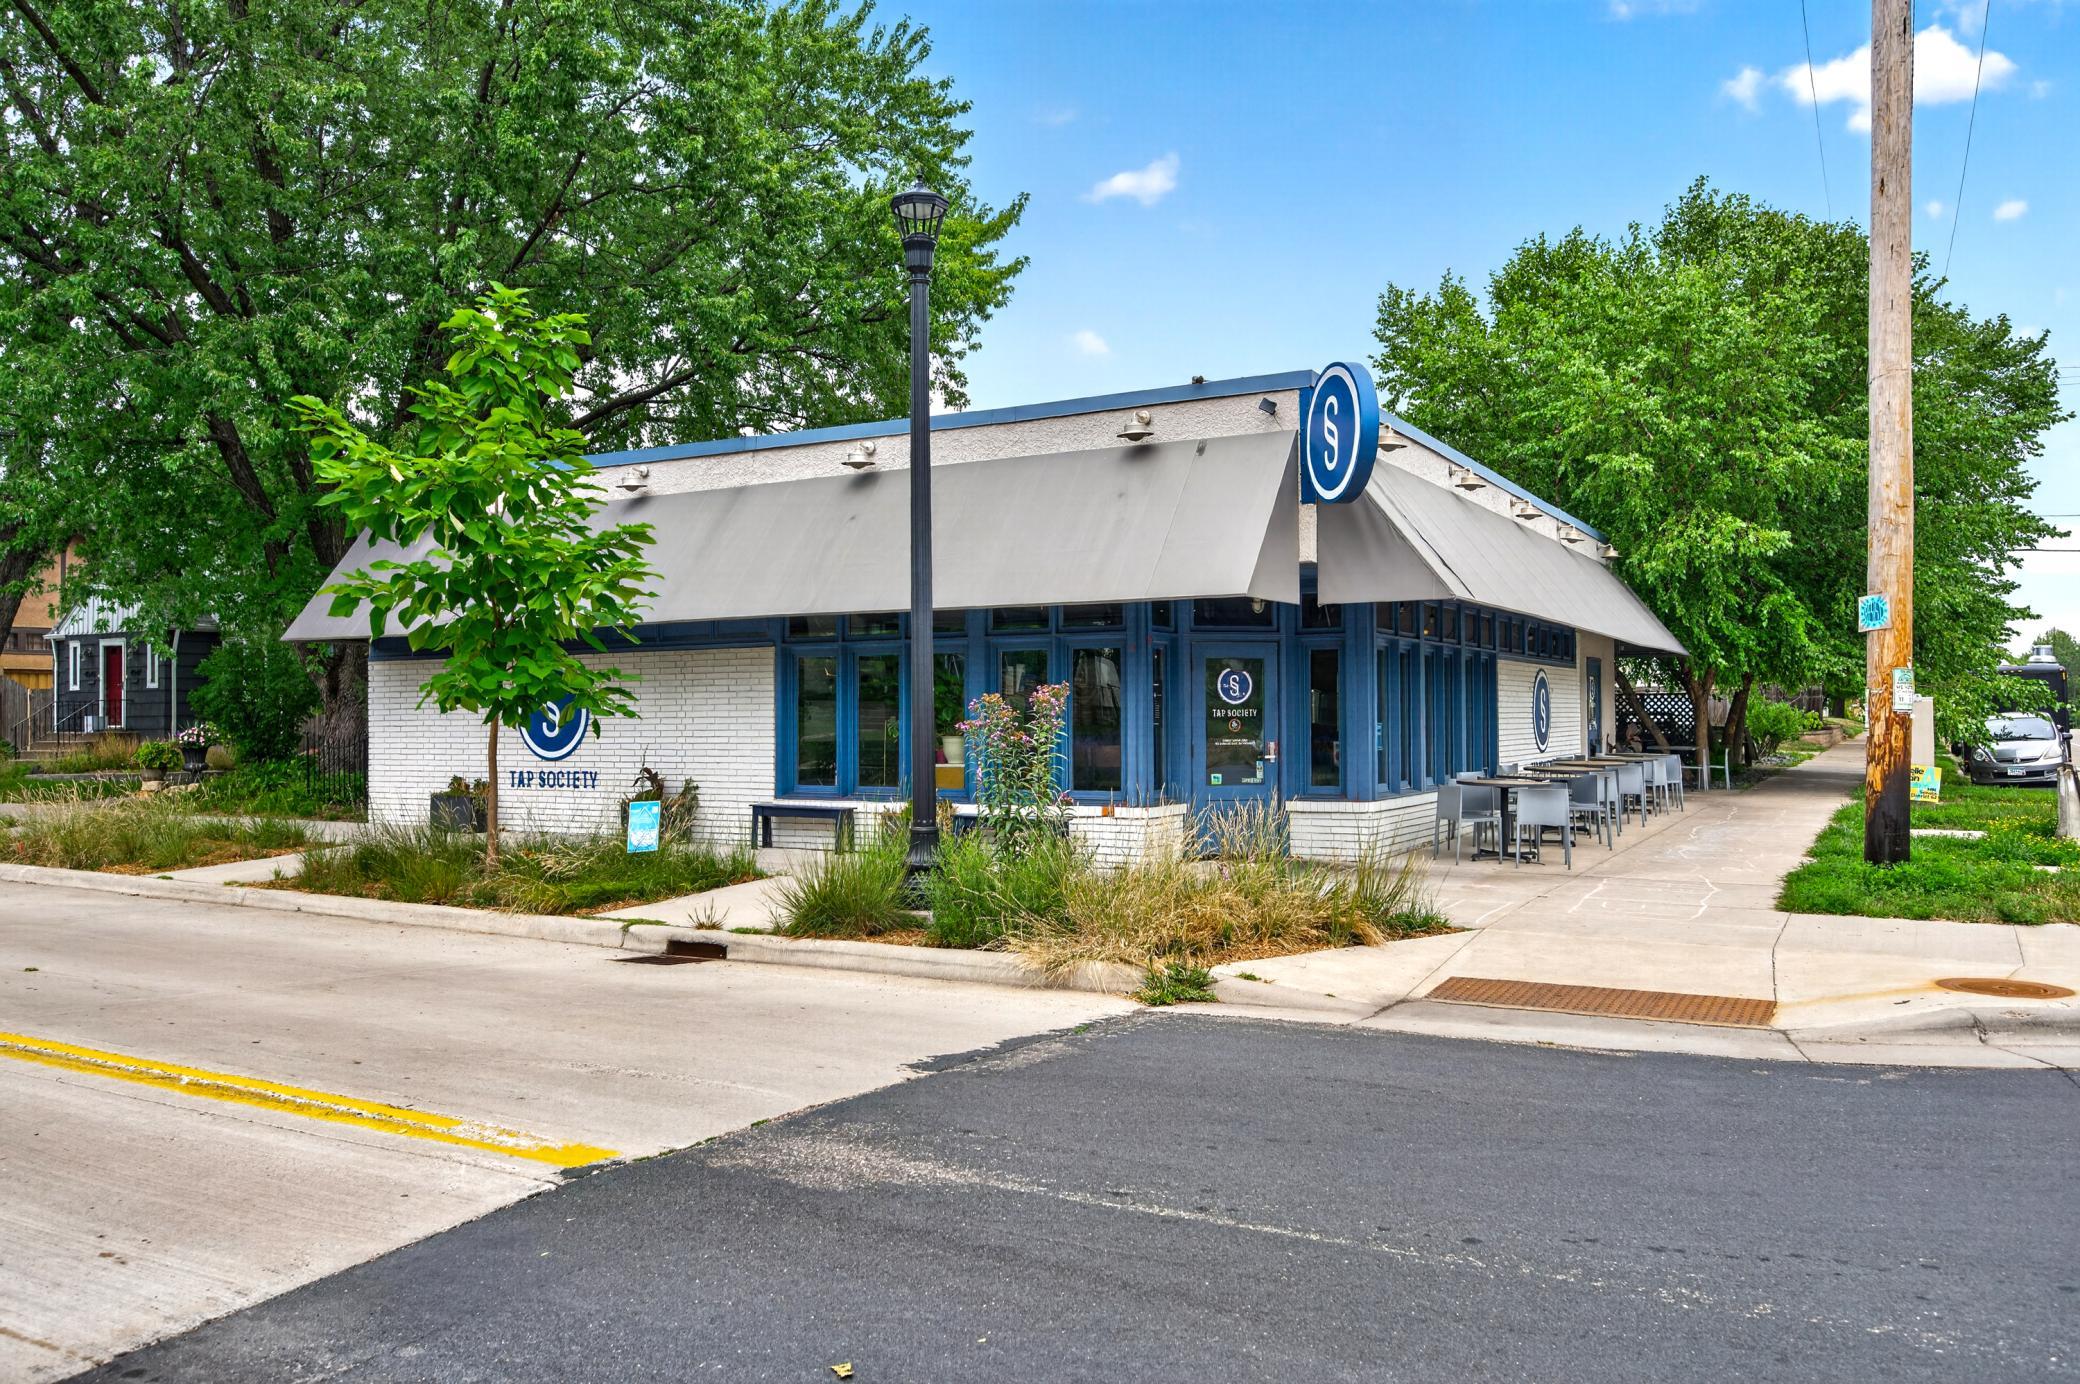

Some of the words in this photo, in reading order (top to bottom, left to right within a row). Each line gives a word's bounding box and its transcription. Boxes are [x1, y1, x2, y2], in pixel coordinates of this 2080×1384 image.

[1212, 708, 1226, 718] TAP
[1227, 708, 1258, 718] SOCIETY
[509, 770, 534, 789] TAP
[538, 770, 598, 789] SOCIETY
